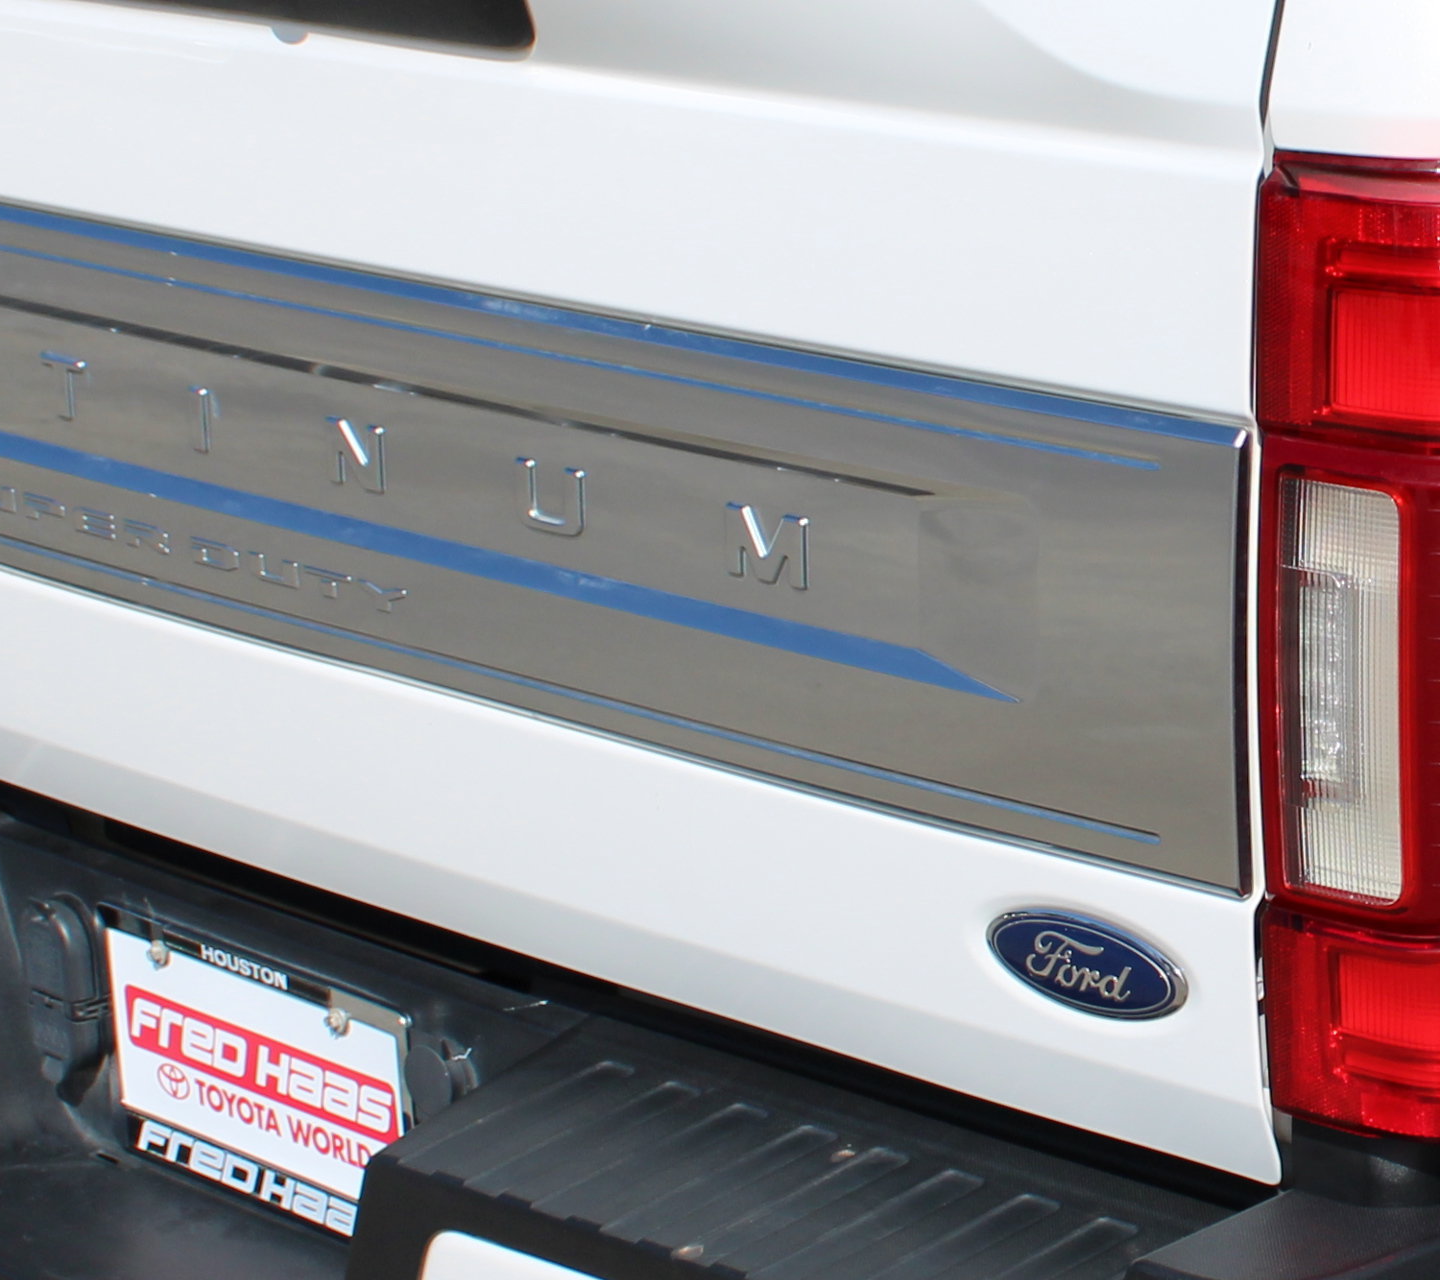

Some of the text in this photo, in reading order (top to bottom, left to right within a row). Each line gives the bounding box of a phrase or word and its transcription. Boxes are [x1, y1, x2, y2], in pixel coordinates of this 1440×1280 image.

[190, 536, 408, 613] DUTY
[201, 944, 288, 990] HOUSTON
[1026, 931, 1132, 1001] Ford
[196, 1079, 372, 1169] TOYOTA WORLD
